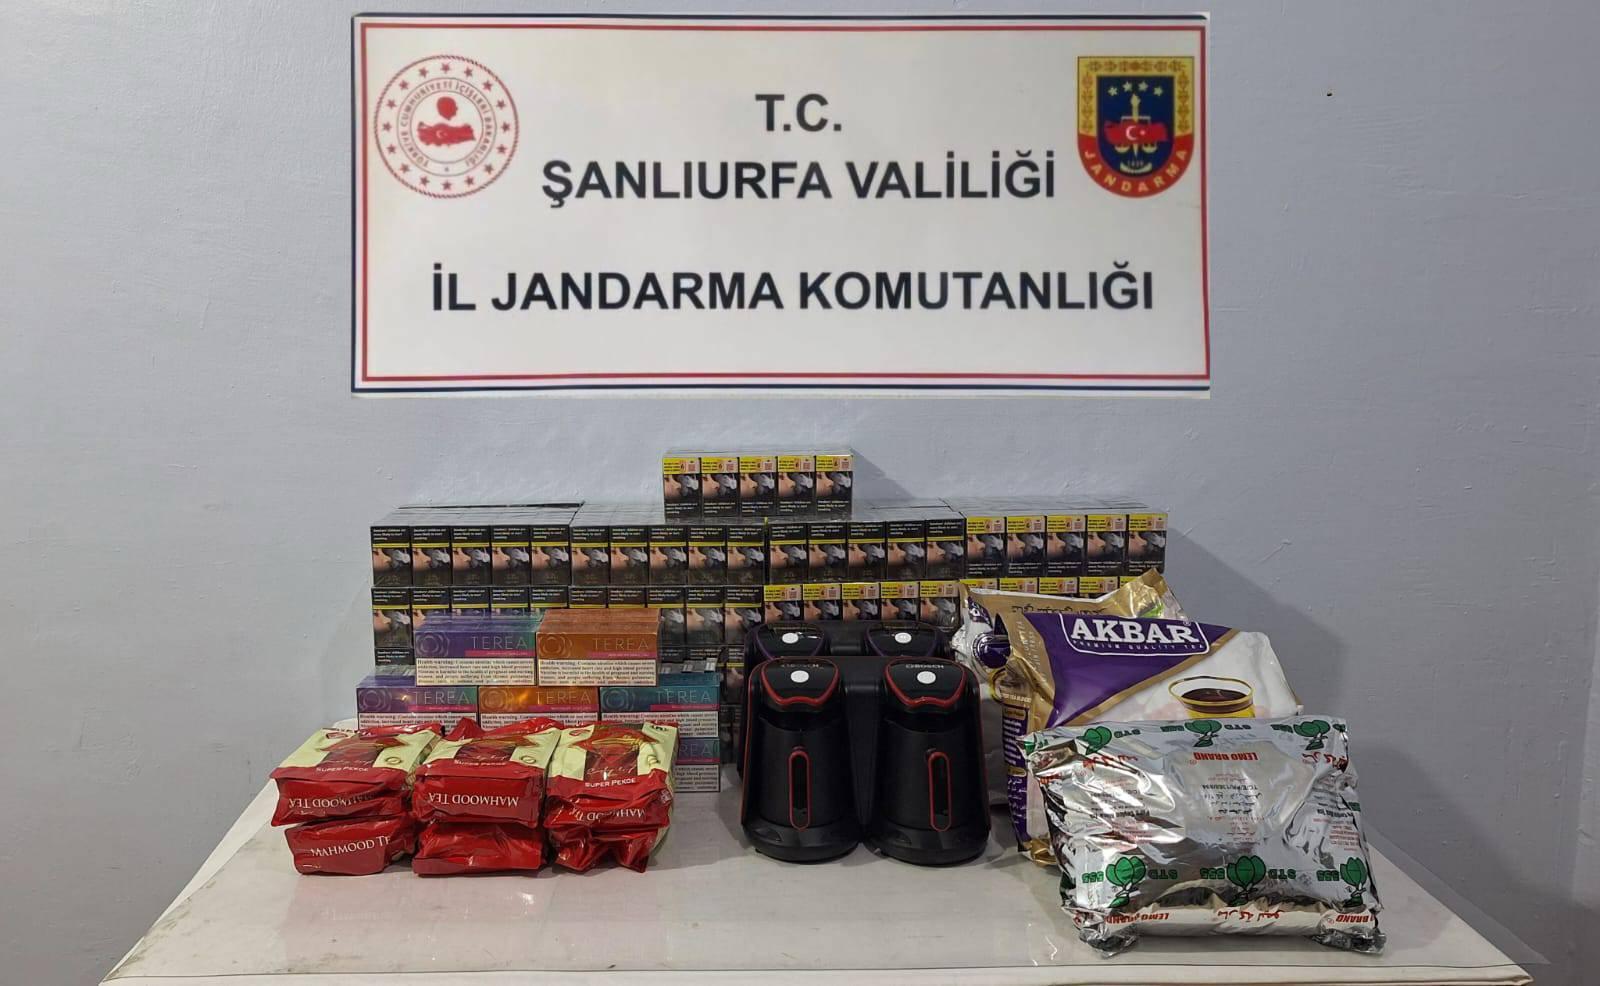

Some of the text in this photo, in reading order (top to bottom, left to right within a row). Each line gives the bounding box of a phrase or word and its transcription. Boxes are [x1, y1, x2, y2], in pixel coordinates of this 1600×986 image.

[755, 93, 842, 132] T.C.
[1084, 150, 1187, 192] JANDARMA
[542, 149, 1055, 209] ŞANLIURFA VALİLİĞİ
[433, 261, 1153, 311] İL JANDARMA KOMUTANLIĞI
[1070, 618, 1200, 643] AKBAR
[471, 636, 528, 650] TEREA
[592, 637, 649, 651] TEREA
[411, 691, 470, 705] TEREA
[535, 691, 592, 705] TEREA
[656, 688, 712, 704] TEREA
[680, 743, 713, 757] REA
[1193, 752, 1230, 762] BRAND
[611, 777, 637, 787] PEKOE
[288, 797, 311, 808] TEA
[428, 792, 519, 807] MAHMOOD TEA
[310, 839, 375, 857] MAHMOOD
[1081, 869, 1178, 884] 555 STD
[1200, 868, 1297, 880] 555 STD
[1316, 870, 1340, 882] 555
[1336, 914, 1369, 924] BRAND
